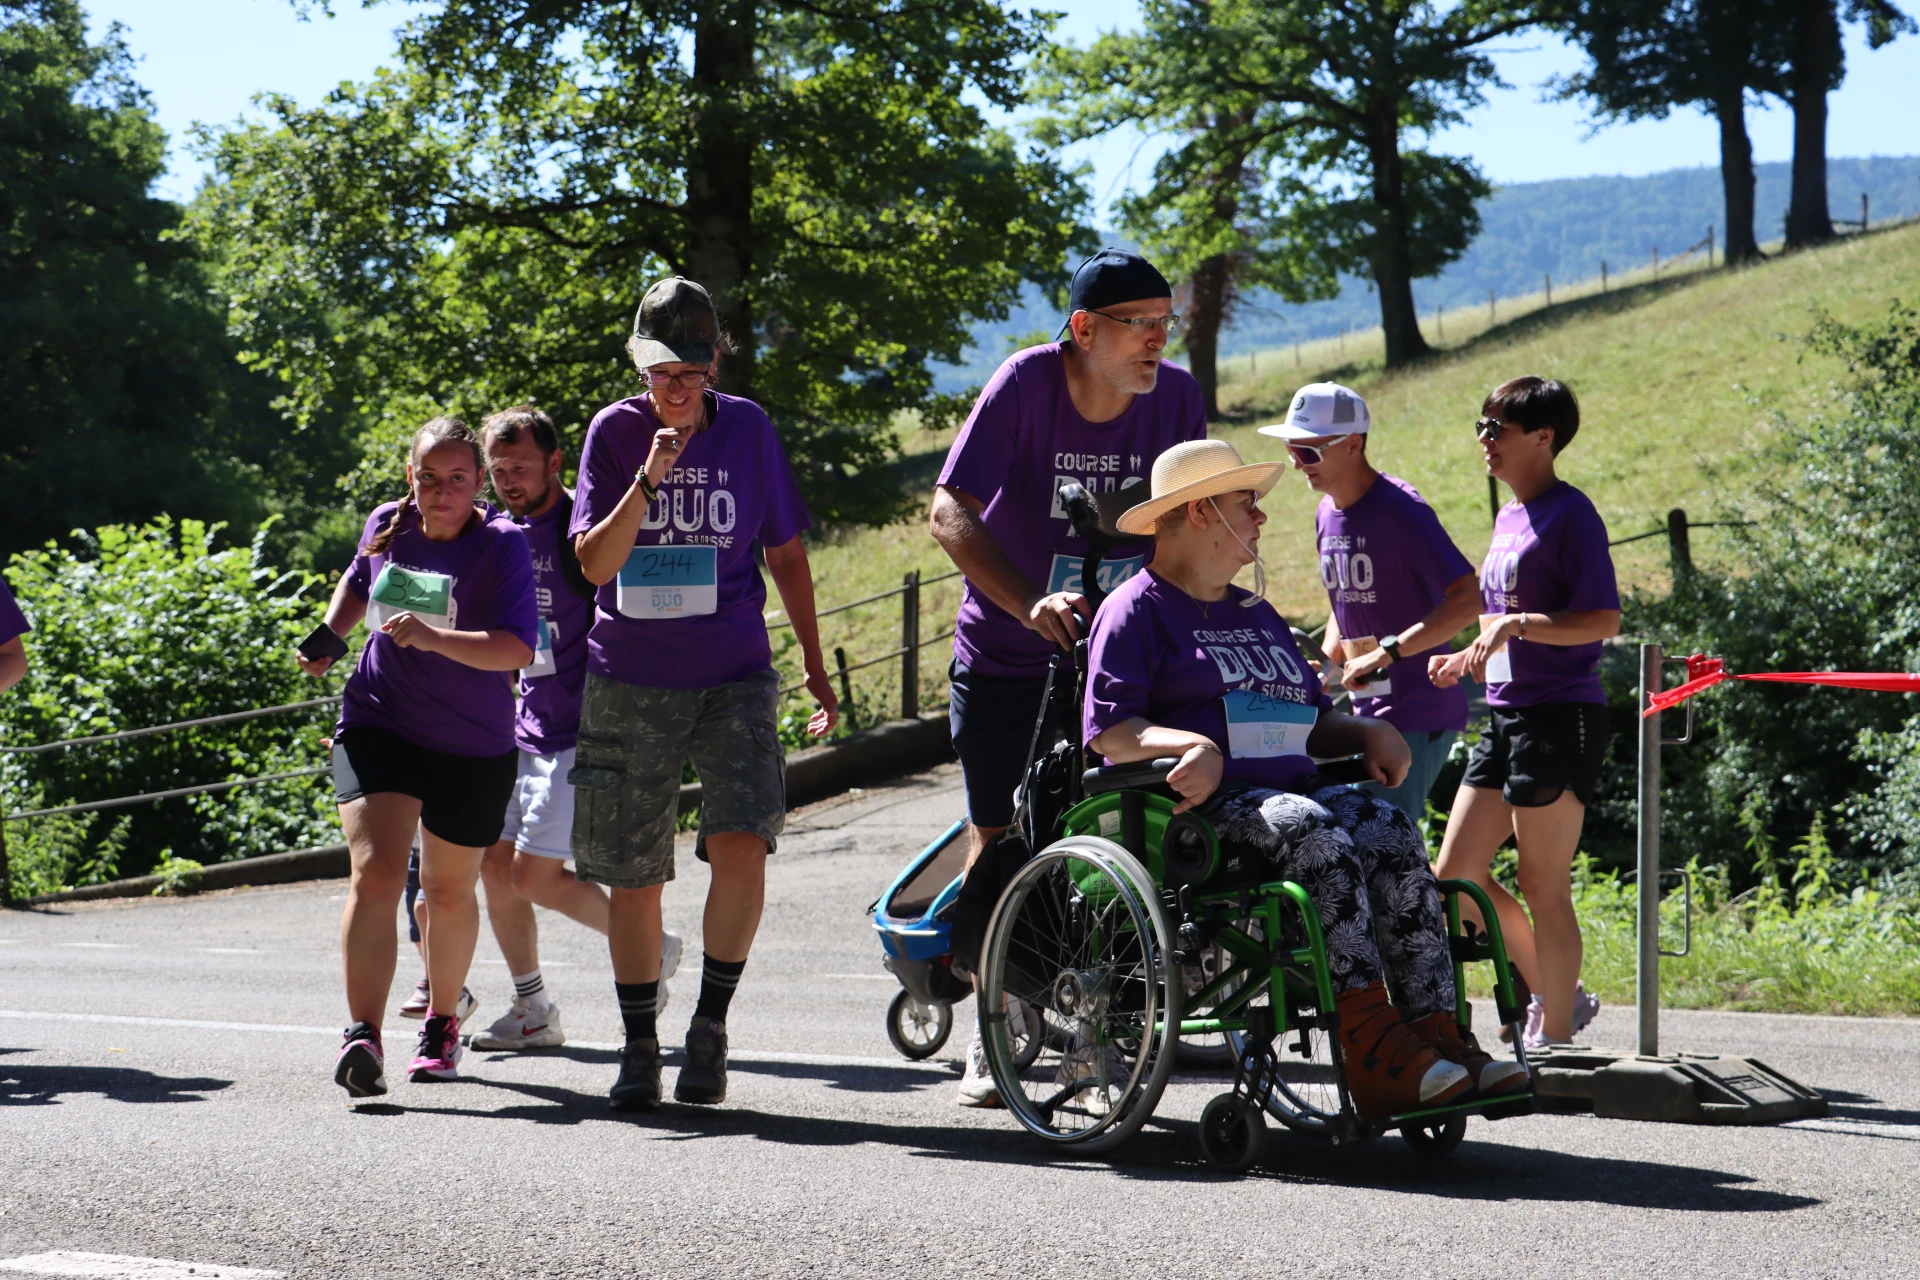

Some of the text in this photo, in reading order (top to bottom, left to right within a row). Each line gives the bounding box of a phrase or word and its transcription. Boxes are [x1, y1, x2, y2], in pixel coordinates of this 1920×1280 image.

[1054, 452, 1121, 472] COURSE
[661, 467, 709, 484] URSE
[640, 489, 736, 533] DUO
[684, 534, 734, 549] SUISSE
[641, 553, 694, 577] 244
[1320, 552, 1374, 590] DUO
[1062, 562, 1136, 592] 244
[387, 572, 431, 609] 32
[652, 593, 683, 607] DUO
[1192, 628, 1259, 644] COURSE
[1205, 645, 1304, 684] DUO
[1243, 692, 1291, 712] 244
[1261, 683, 1307, 704] SUISSE
[1263, 731, 1286, 745] DUO
